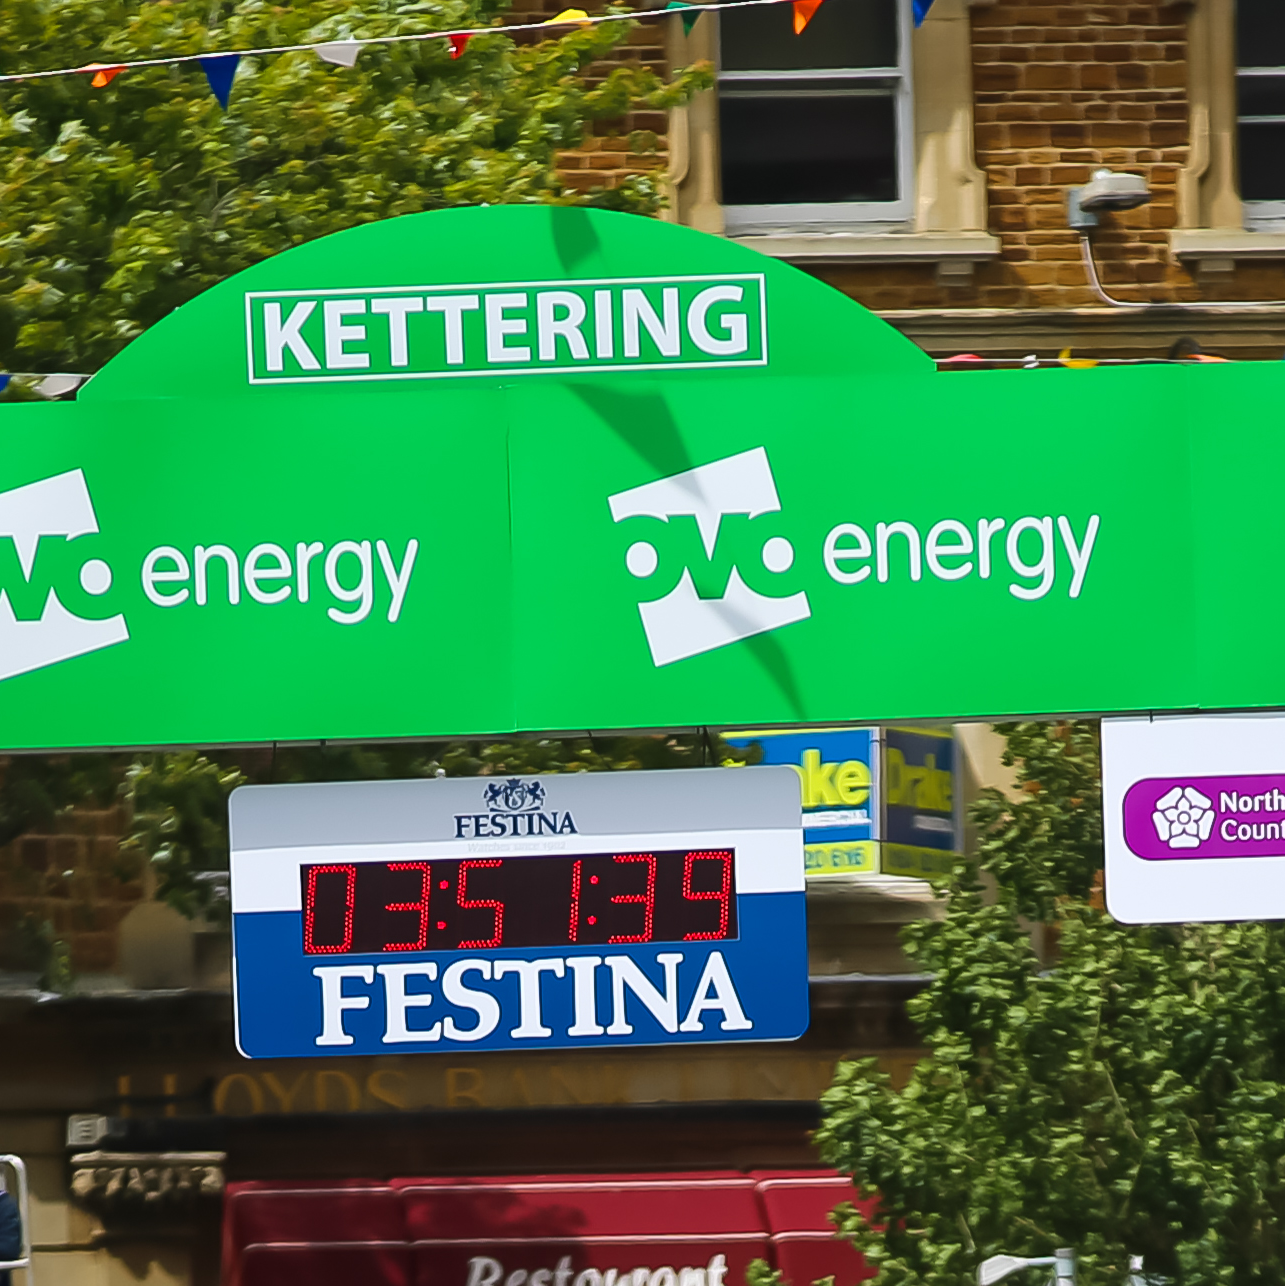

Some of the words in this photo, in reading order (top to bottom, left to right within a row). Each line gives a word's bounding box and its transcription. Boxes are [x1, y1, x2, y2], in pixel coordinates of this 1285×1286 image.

[263, 286, 749, 373] KETTERING
[141, 538, 419, 625] energy
[822, 514, 1101, 600] energy
[454, 811, 578, 838] FESTINA
[313, 951, 753, 1046] FESTINA
